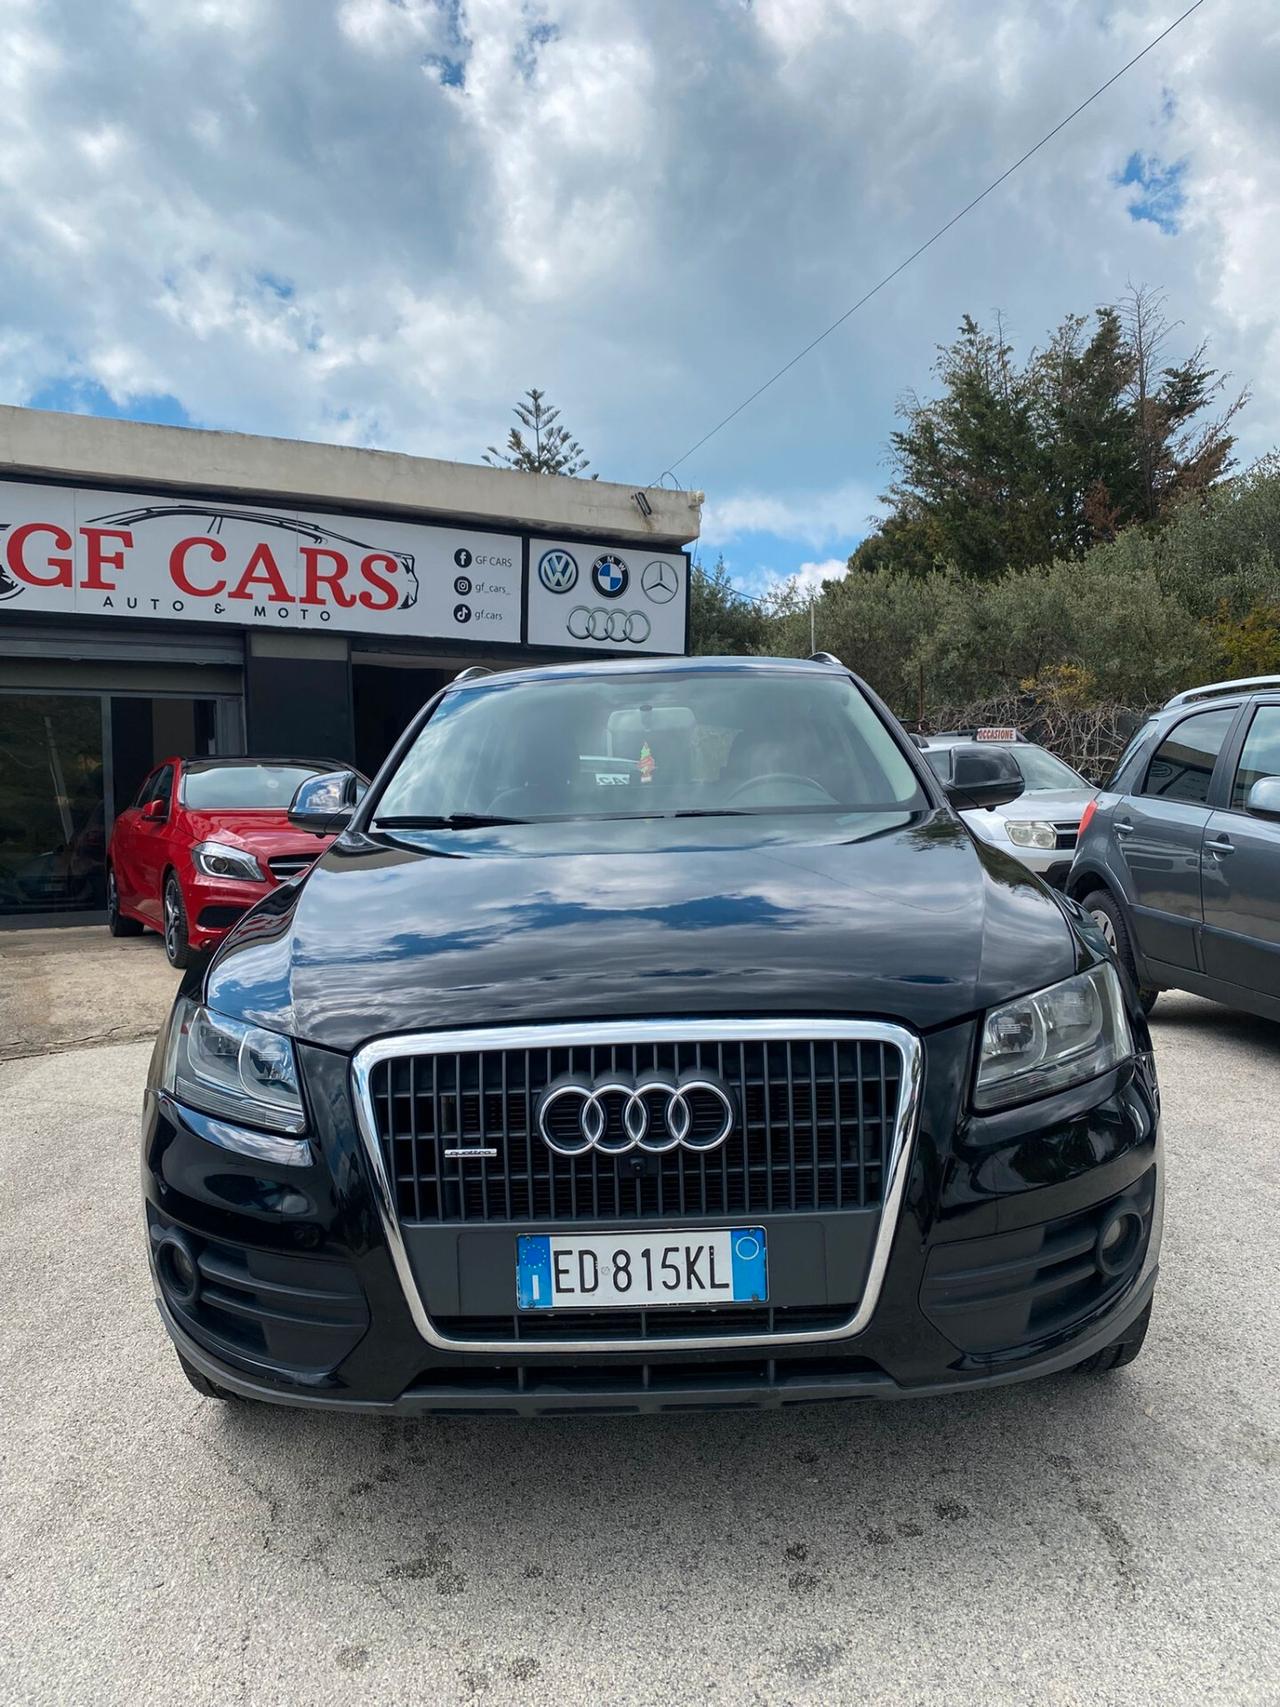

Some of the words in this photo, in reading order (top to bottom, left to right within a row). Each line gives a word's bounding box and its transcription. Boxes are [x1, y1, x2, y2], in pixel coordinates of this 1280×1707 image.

[6, 522, 134, 591] GF
[168, 536, 400, 611] CARS
[475, 555, 488, 565] GF
[489, 556, 513, 568] CARS
[595, 556, 626, 572] BMW
[103, 596, 185, 612] AUTO
[214, 603, 226, 614] &
[254, 605, 331, 622] MOTO
[474, 608, 503, 621] gf.cars
[977, 729, 1014, 740] OCCASIONE
[553, 1249, 599, 1294] ED
[612, 1245, 730, 1293] 815KL
